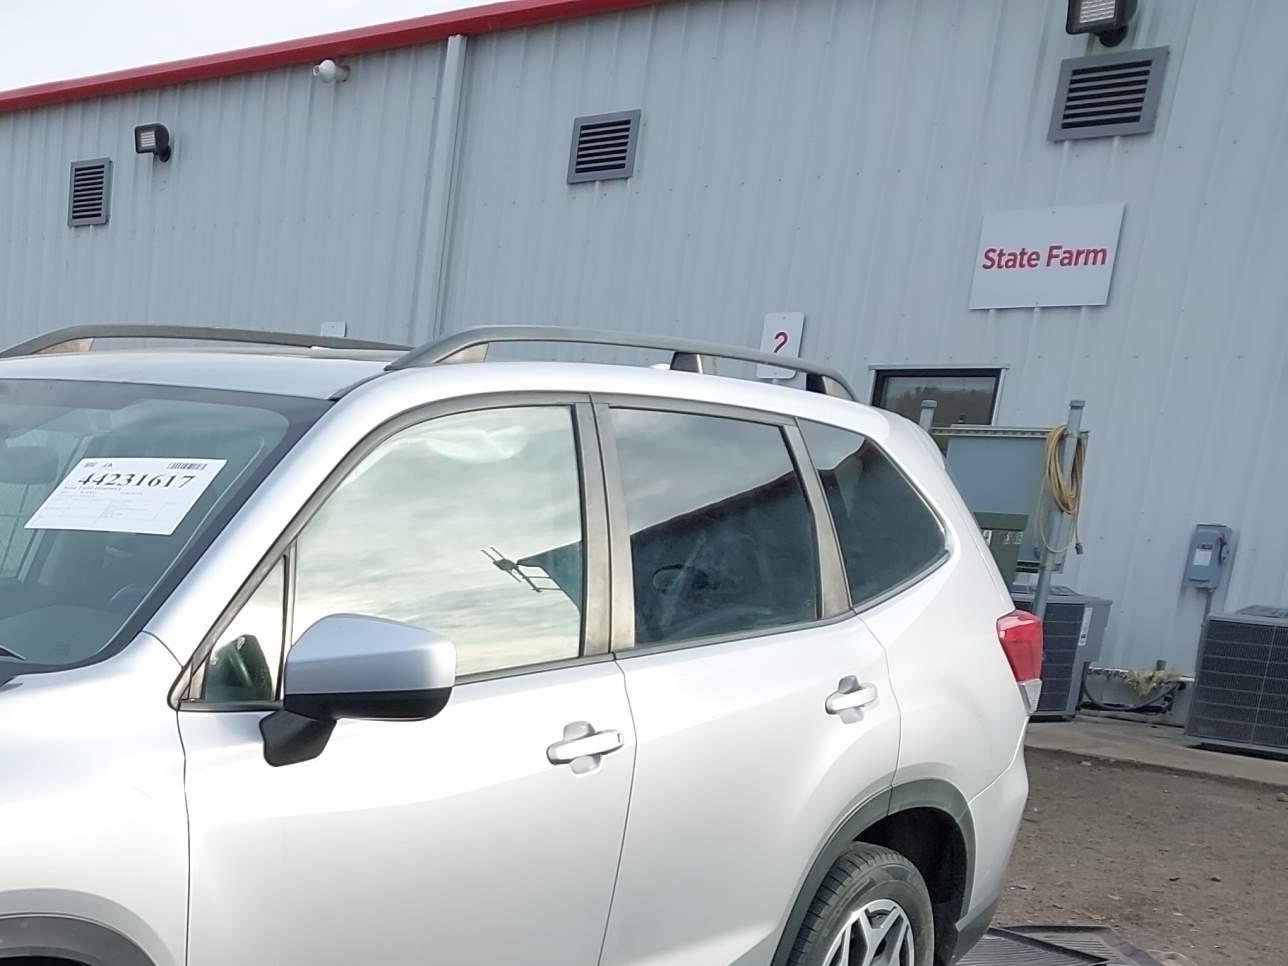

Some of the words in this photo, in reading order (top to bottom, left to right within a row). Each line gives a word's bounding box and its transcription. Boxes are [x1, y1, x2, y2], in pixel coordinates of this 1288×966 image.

[982, 247, 1041, 270] State
[1046, 245, 1107, 267] Farm
[774, 331, 789, 353] 2
[78, 473, 196, 489] 44231617
